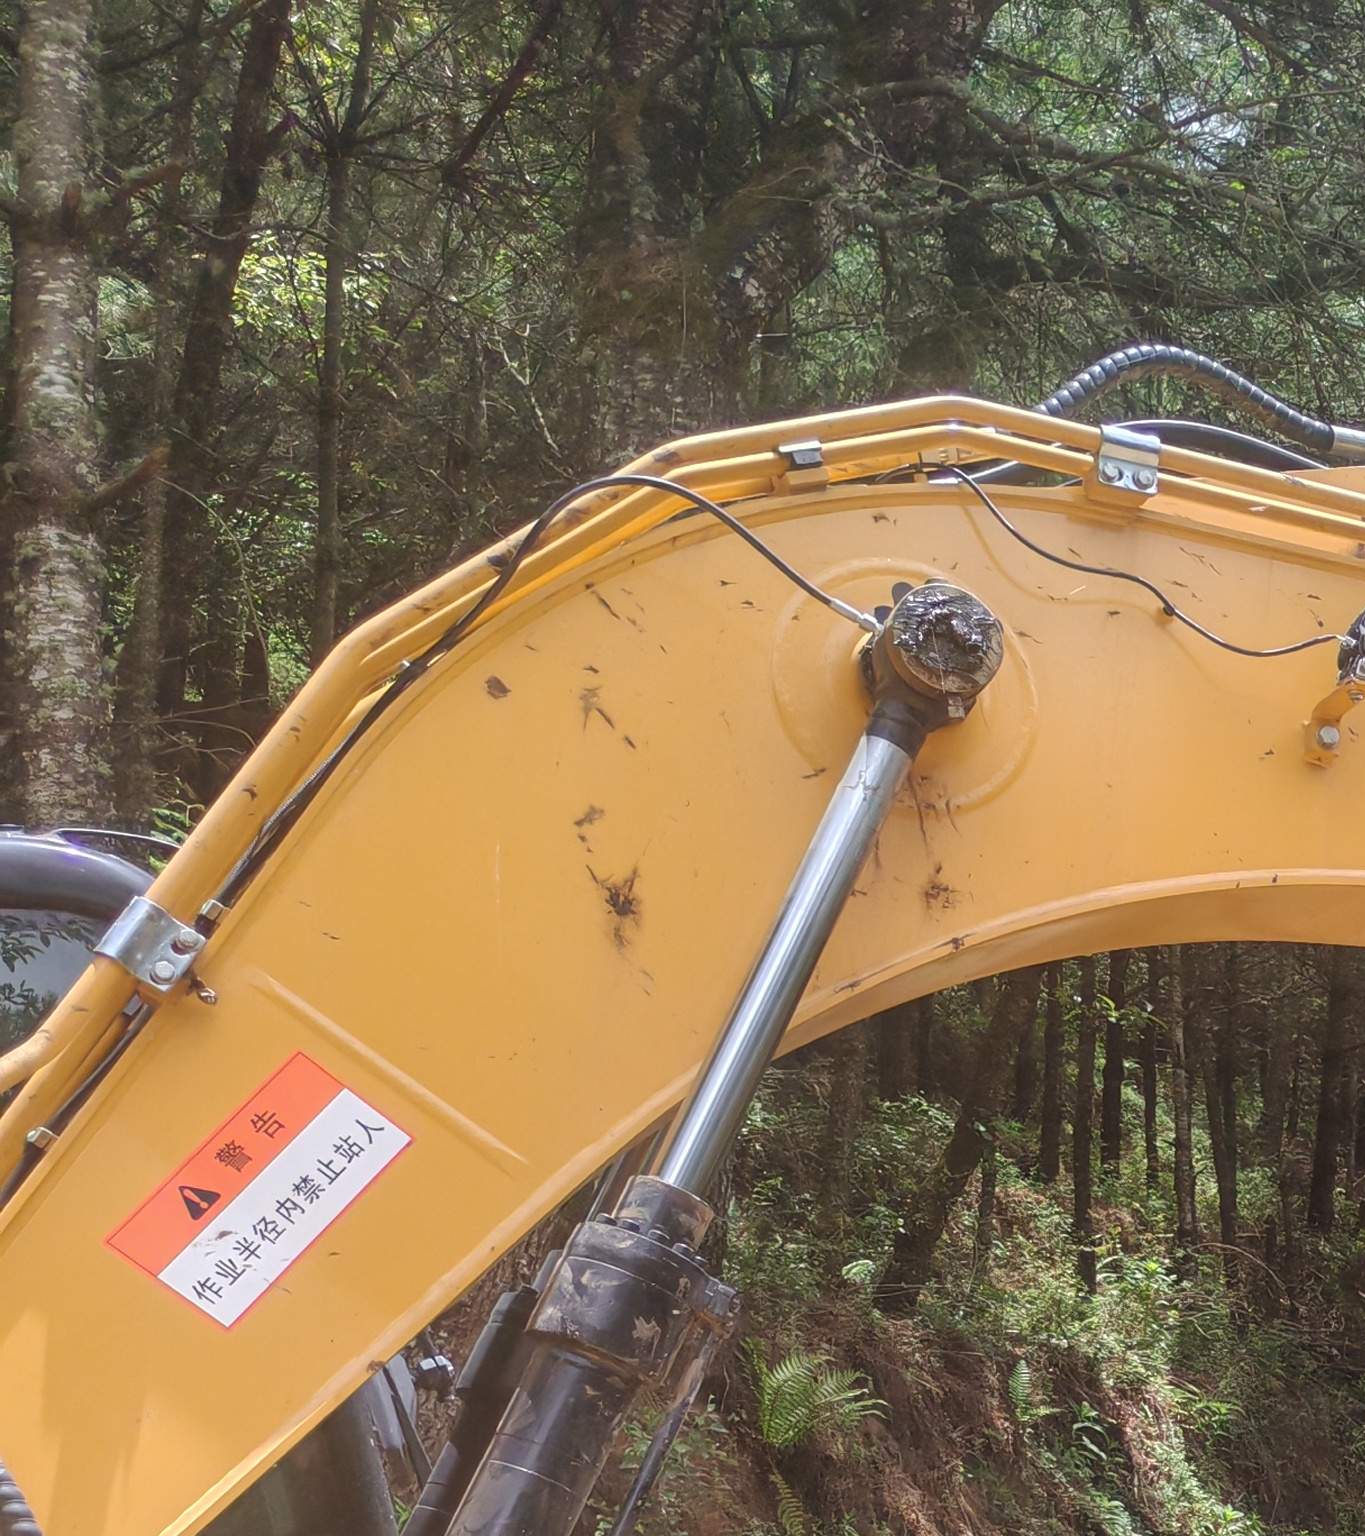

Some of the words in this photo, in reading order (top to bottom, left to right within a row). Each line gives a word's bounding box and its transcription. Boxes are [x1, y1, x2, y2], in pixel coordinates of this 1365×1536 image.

[214, 1110, 286, 1173] 警告
[191, 1118, 385, 1305] 作业半径内禁止站人
